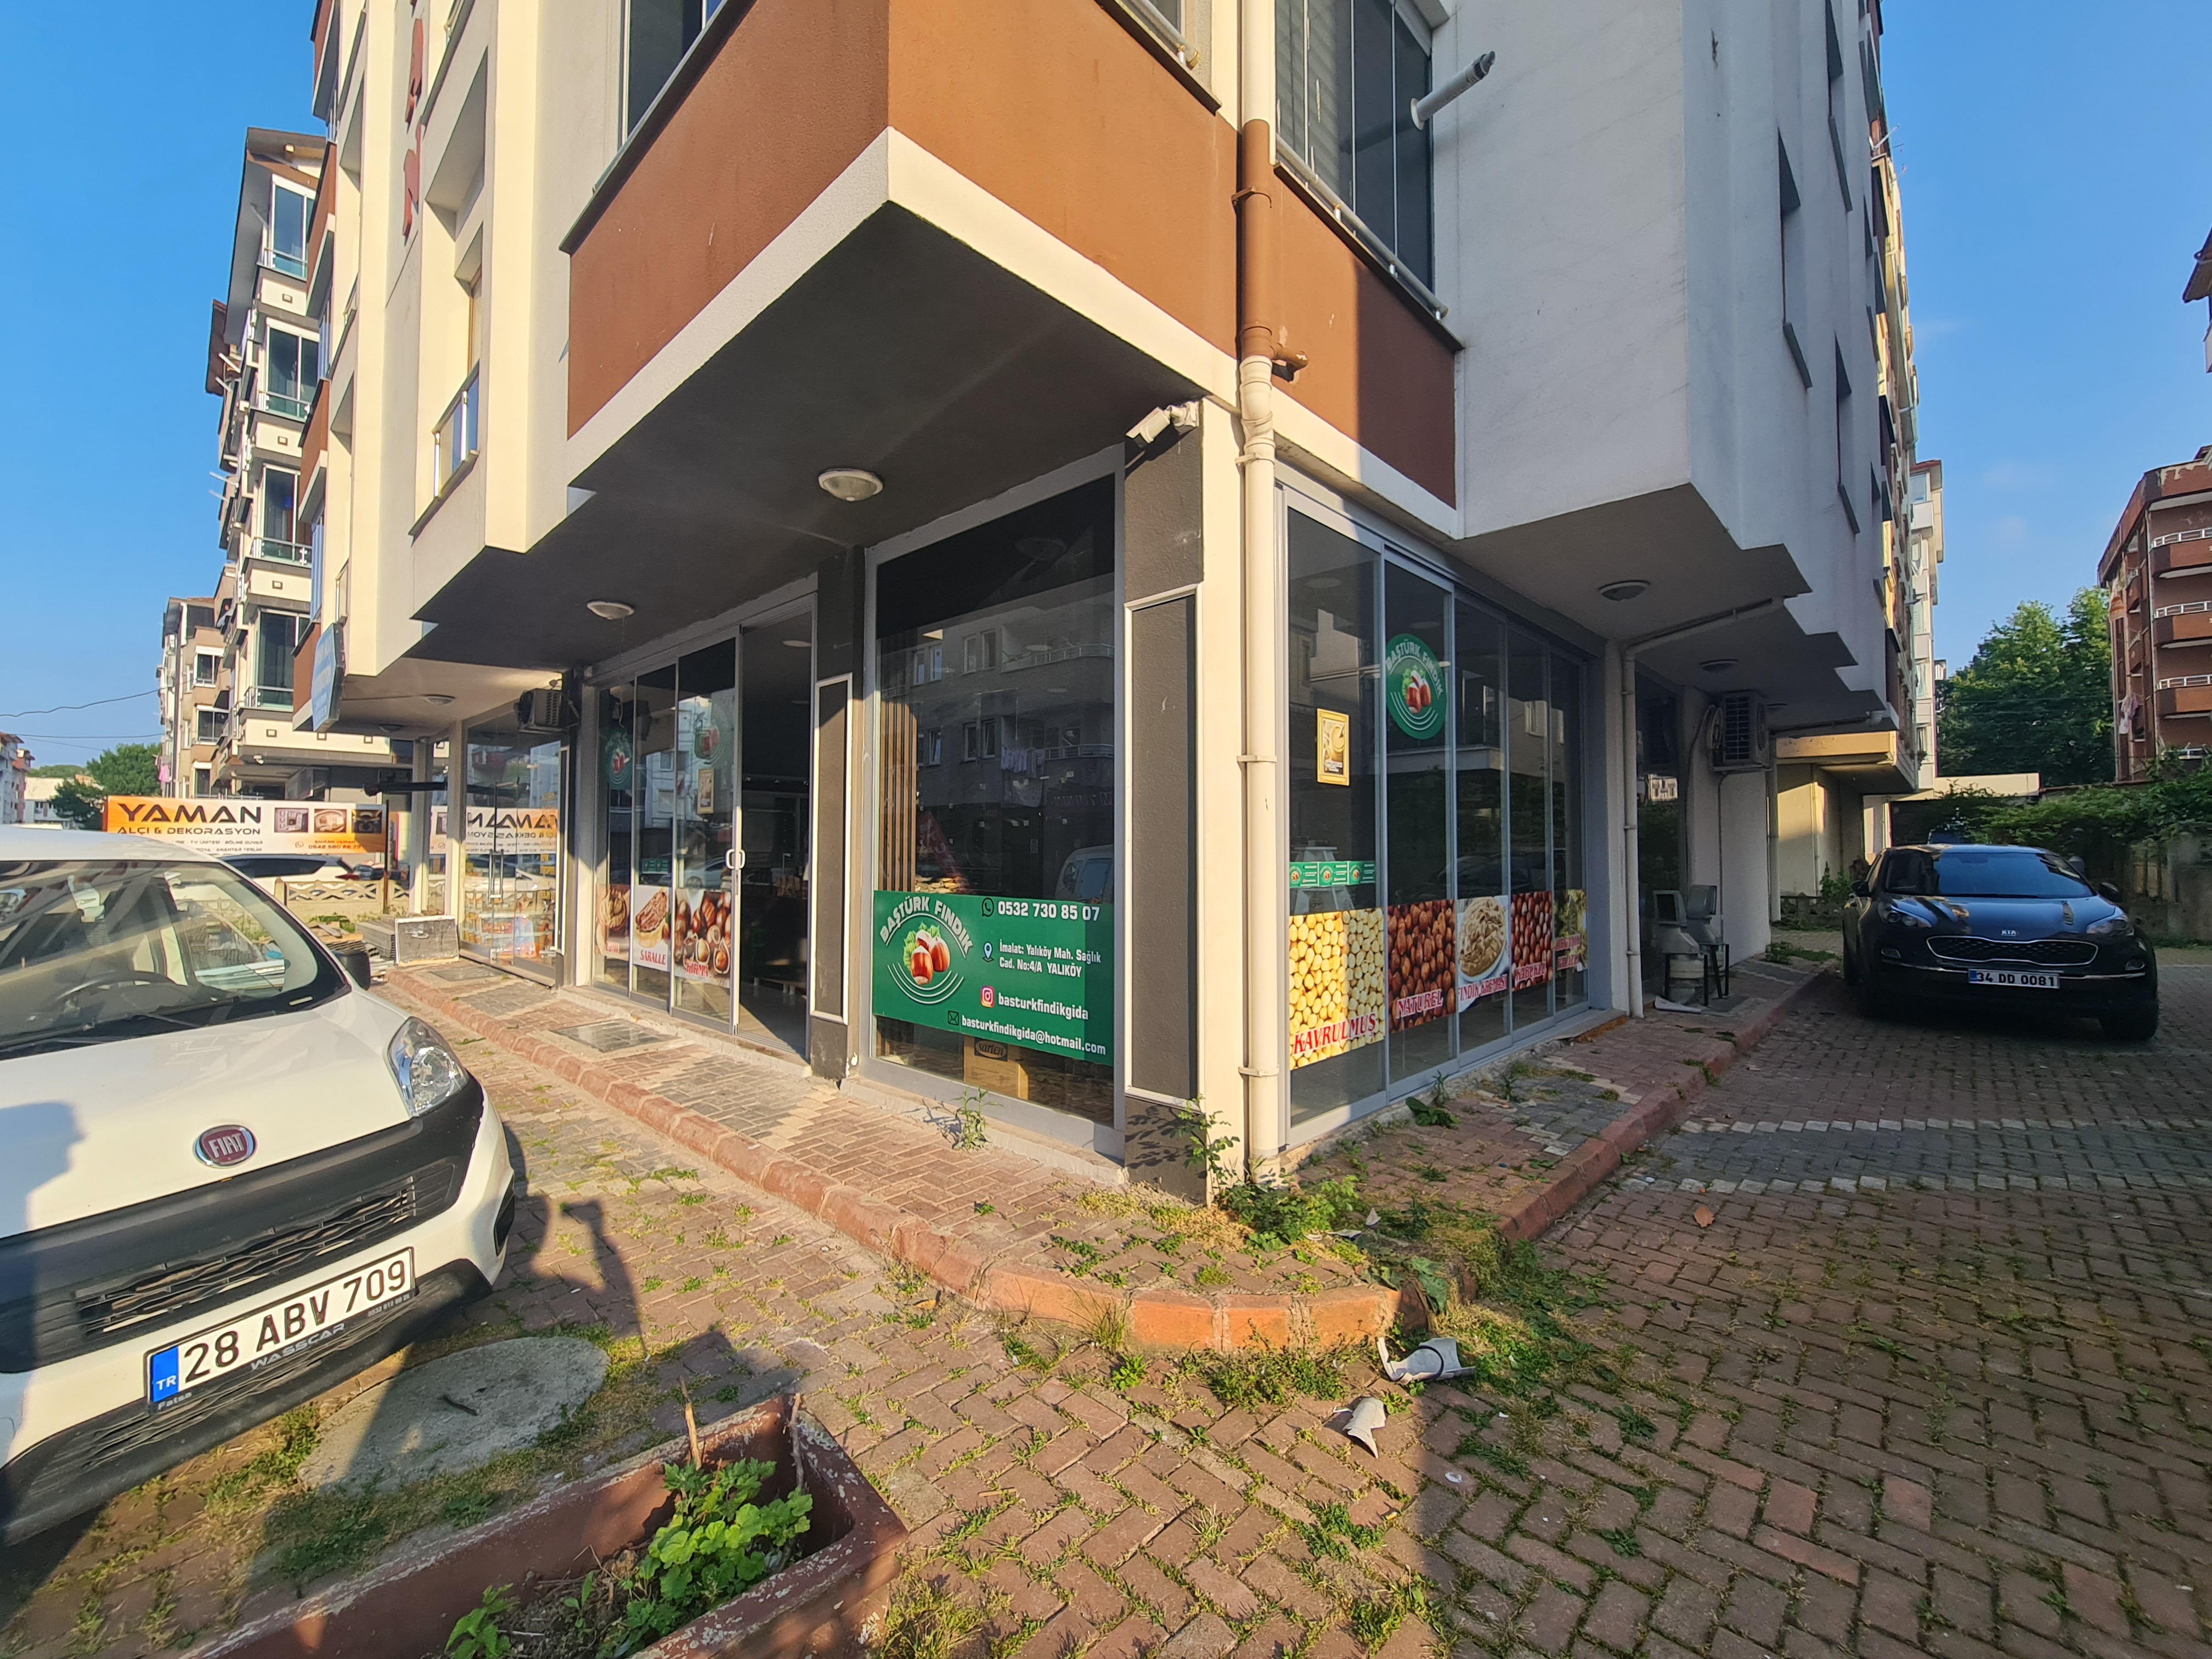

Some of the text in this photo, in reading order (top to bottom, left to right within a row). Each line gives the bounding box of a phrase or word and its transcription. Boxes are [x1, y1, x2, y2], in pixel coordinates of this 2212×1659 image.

[1422, 651, 1443, 696] FINDIK
[117, 803, 262, 823] YAMAN
[117, 826, 149, 836] ALÇI
[998, 901, 1100, 921] 0532 730 85 07
[880, 895, 974, 954] BAŞTÜRK FINDIK
[640, 950, 667, 966] SARALLE
[1000, 939, 1102, 964] İmalat: Yalıköy Mah. Sağlık
[999, 957, 1082, 978] Cad. No:4/A YALIKÖY
[1977, 972, 2055, 986] 34 DD 0081
[1397, 989, 1444, 1018] NATUREL
[1458, 983, 1479, 1001] INDIK
[998, 992, 1088, 1020] basturkfindikgida
[962, 1015, 1106, 1056] basturkfindikgida@hotmail.com
[1293, 1013, 1376, 1055] KAVRULMUŞ
[208, 1132, 244, 1159] FIAT
[184, 1260, 405, 1384] 28 ABV 709
[250, 1322, 346, 1370] WASSCAR
[156, 1374, 177, 1391] TR
[158, 1391, 192, 1410] Fatsa
